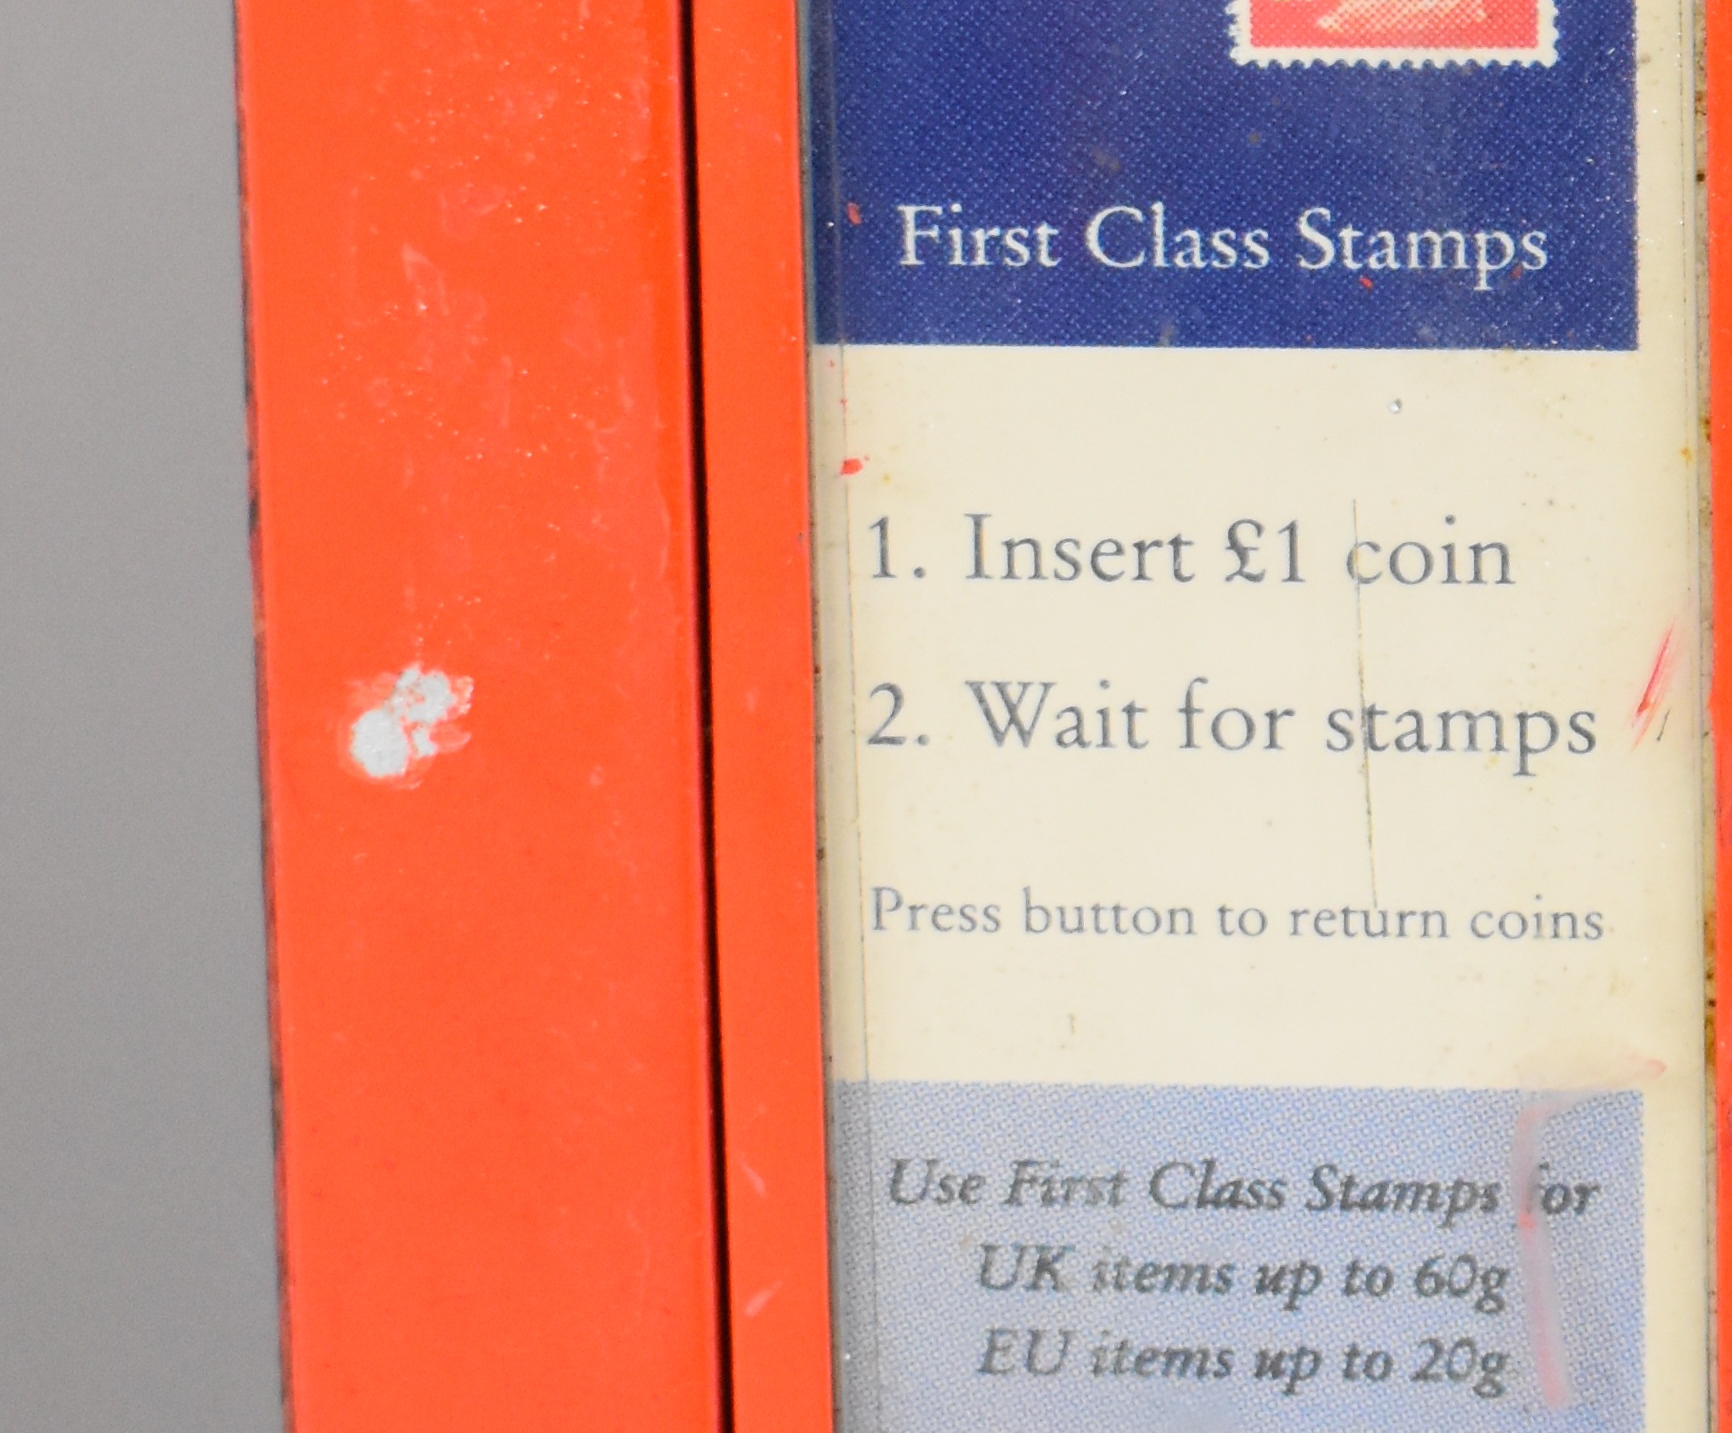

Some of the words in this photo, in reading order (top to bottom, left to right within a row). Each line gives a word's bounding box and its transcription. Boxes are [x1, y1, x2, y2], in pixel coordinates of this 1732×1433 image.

[898, 204, 1061, 268] First
[1085, 202, 1271, 270] Class
[1298, 207, 1550, 292] Stamps
[869, 517, 926, 580] 1.
[963, 513, 1196, 583] Insert
[1225, 520, 1307, 584] £1
[1346, 514, 1516, 586] coin
[866, 685, 931, 747] 2.
[965, 679, 1149, 750] Wait
[1178, 677, 1295, 751] for
[1326, 695, 1596, 778] stamps
[871, 887, 1002, 933] Press
[1023, 887, 1196, 936] button
[1217, 900, 1268, 937] to
[1289, 904, 1449, 940] return
[1469, 894, 1605, 941] coins
[888, 1158, 987, 1206] Use
[1007, 1159, 1126, 1209] First
[1148, 1160, 1286, 1212] Class
[1304, 1163, 1502, 1225] Stamps
[977, 1244, 1074, 1292] UK
[1090, 1250, 1235, 1296] items
[1255, 1263, 1322, 1313] up
[1343, 1259, 1394, 1298] to
[1414, 1255, 1509, 1316] 60g
[978, 1328, 1071, 1378] EU
[1090, 1334, 1235, 1379] items
[1255, 1347, 1322, 1397] up
[1343, 1343, 1394, 1382] to
[1411, 1339, 1509, 1399] 20g
